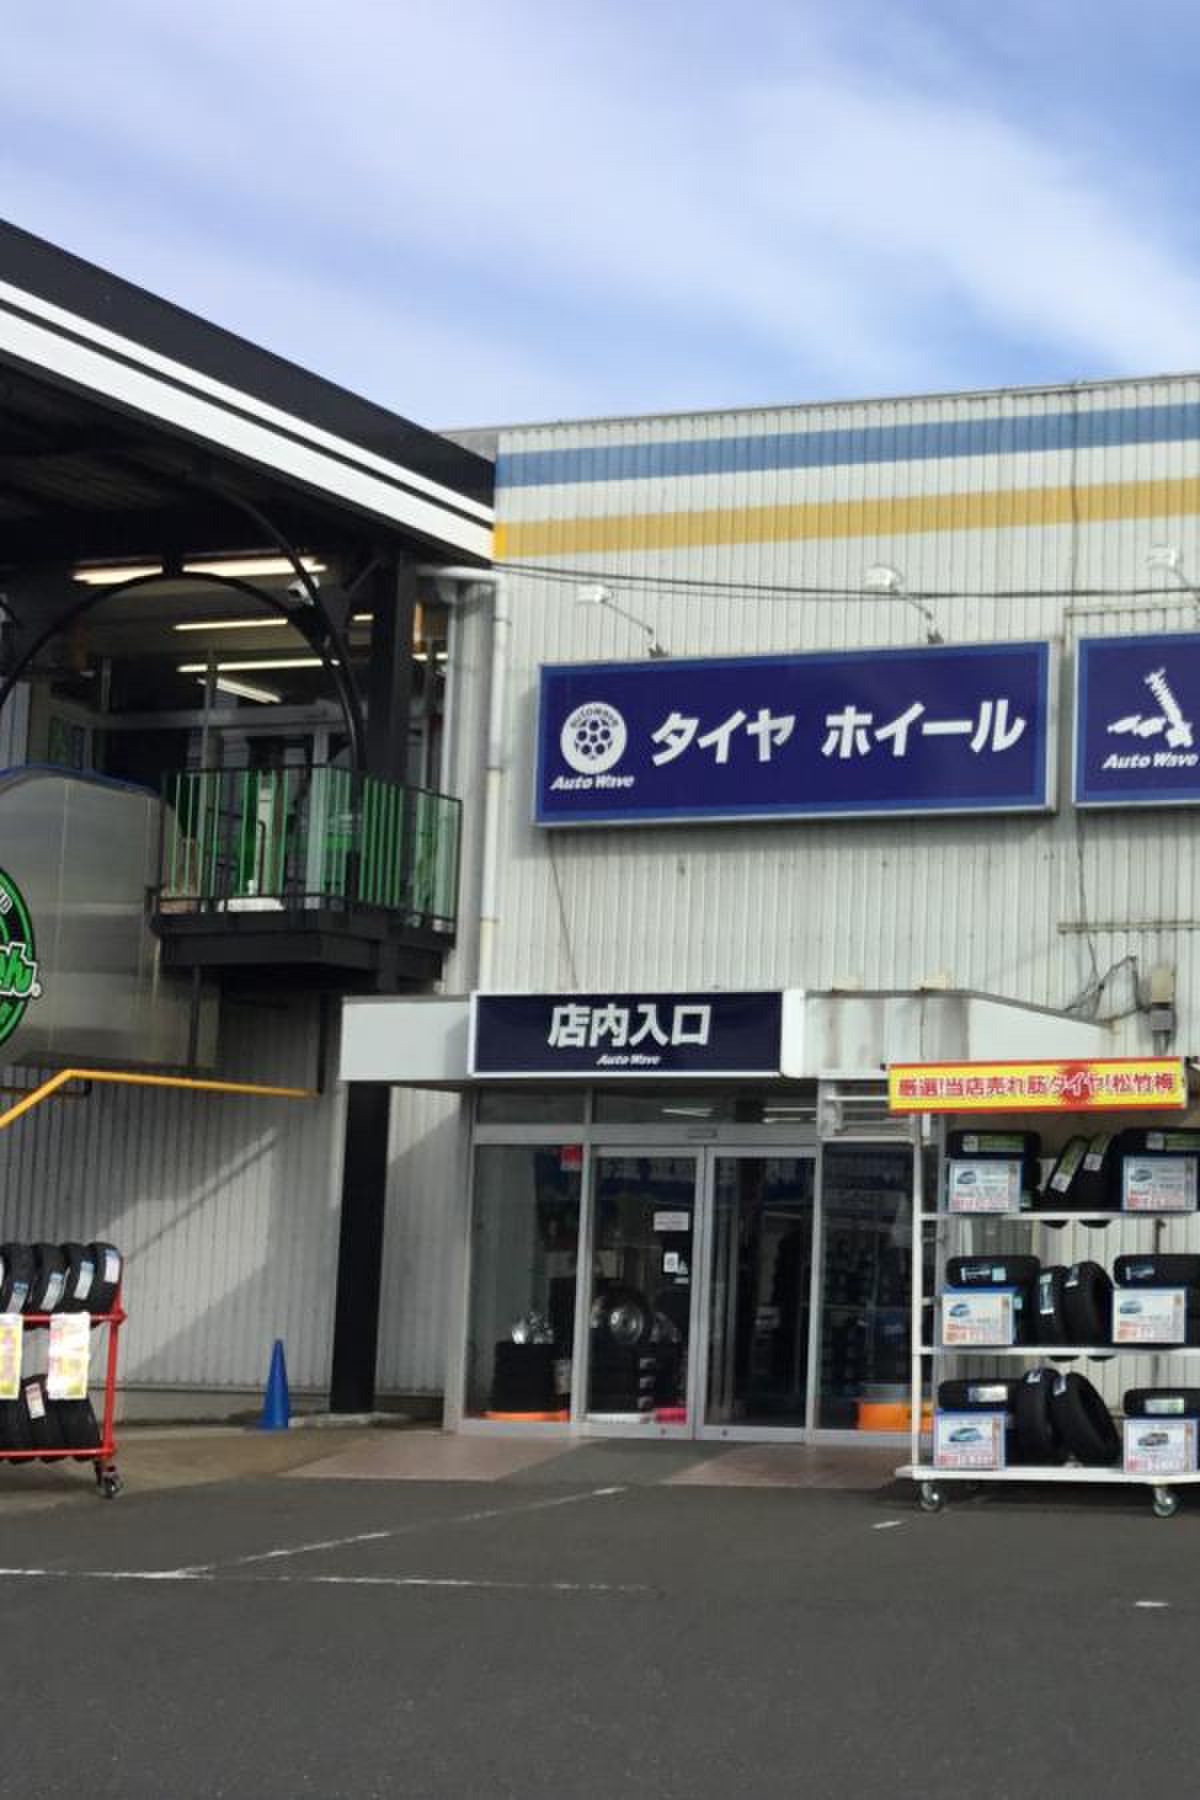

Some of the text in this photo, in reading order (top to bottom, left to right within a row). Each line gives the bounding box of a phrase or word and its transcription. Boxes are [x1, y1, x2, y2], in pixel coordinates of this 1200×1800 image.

[651, 699, 1026, 766] タイヤ ホイール
[1102, 752, 1198, 769] Auto Wave
[549, 774, 635, 790] Auto Wave
[548, 1003, 712, 1047] 店内入口
[596, 1054, 629, 1066] Auto
